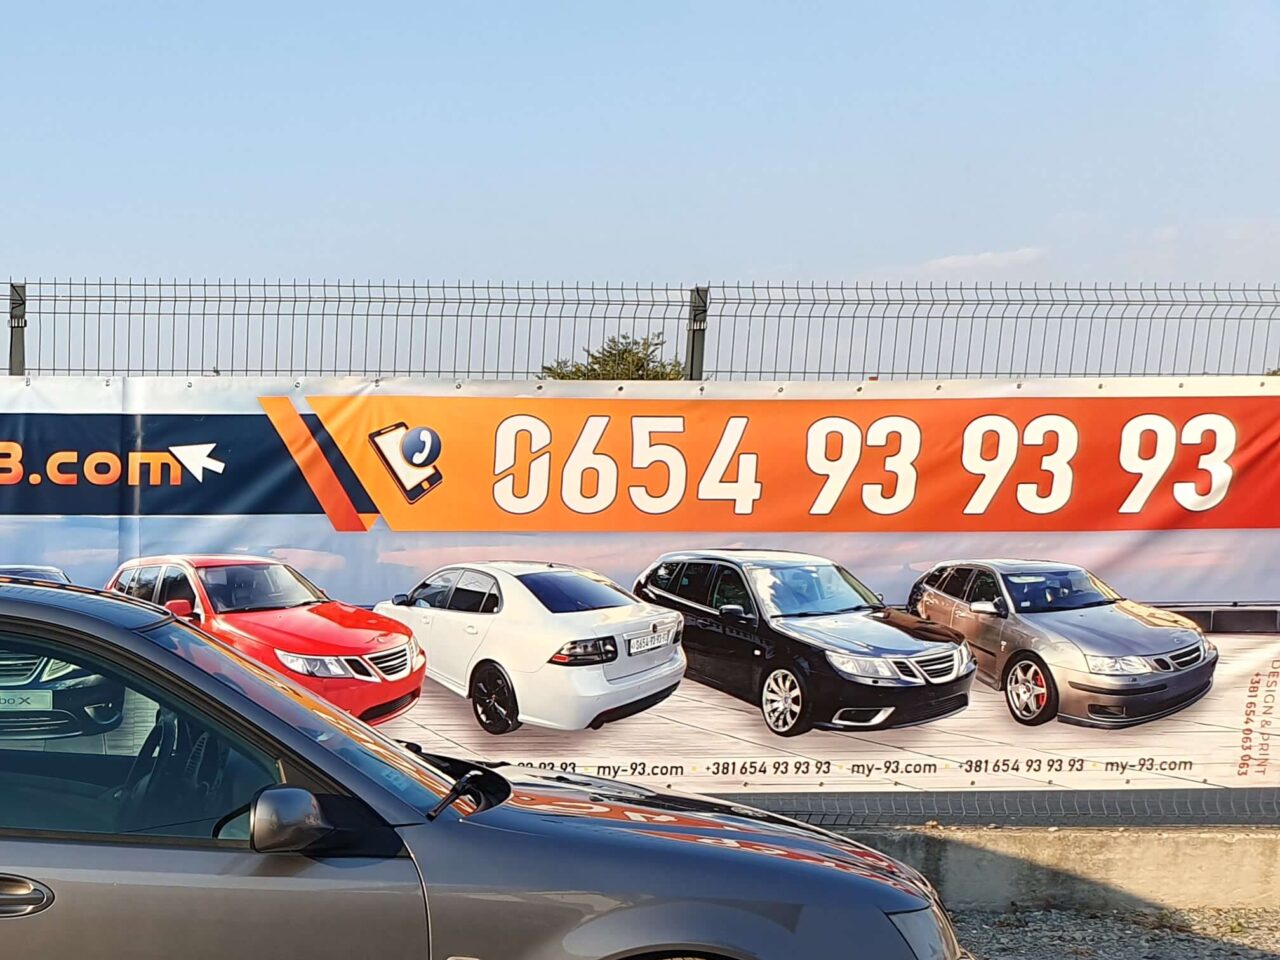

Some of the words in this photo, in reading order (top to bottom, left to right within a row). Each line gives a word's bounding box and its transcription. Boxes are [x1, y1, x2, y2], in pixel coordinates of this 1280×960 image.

[492, 414, 762, 515] 0654
[805, 415, 922, 515] 93
[960, 413, 1079, 515] 93
[1117, 412, 1237, 514] 93
[1247, 672, 1261, 698] +381
[1262, 660, 1280, 715] DESIGN
[18, 696, 31, 705] X
[1244, 702, 1256, 724] 654
[1260, 719, 1272, 728] &
[1241, 728, 1253, 751] 063
[1255, 732, 1271, 775] PRINT
[597, 762, 684, 778] my-93.com
[773, 761, 789, 774] 93
[794, 761, 810, 774] 93
[815, 761, 831, 774] 93
[851, 760, 937, 777] my-93.com
[1025, 759, 1042, 772] 93
[1047, 759, 1063, 772] 93
[1068, 758, 1084, 771] 93
[1105, 758, 1193, 775] my-93.com
[1237, 754, 1252, 776] 063
